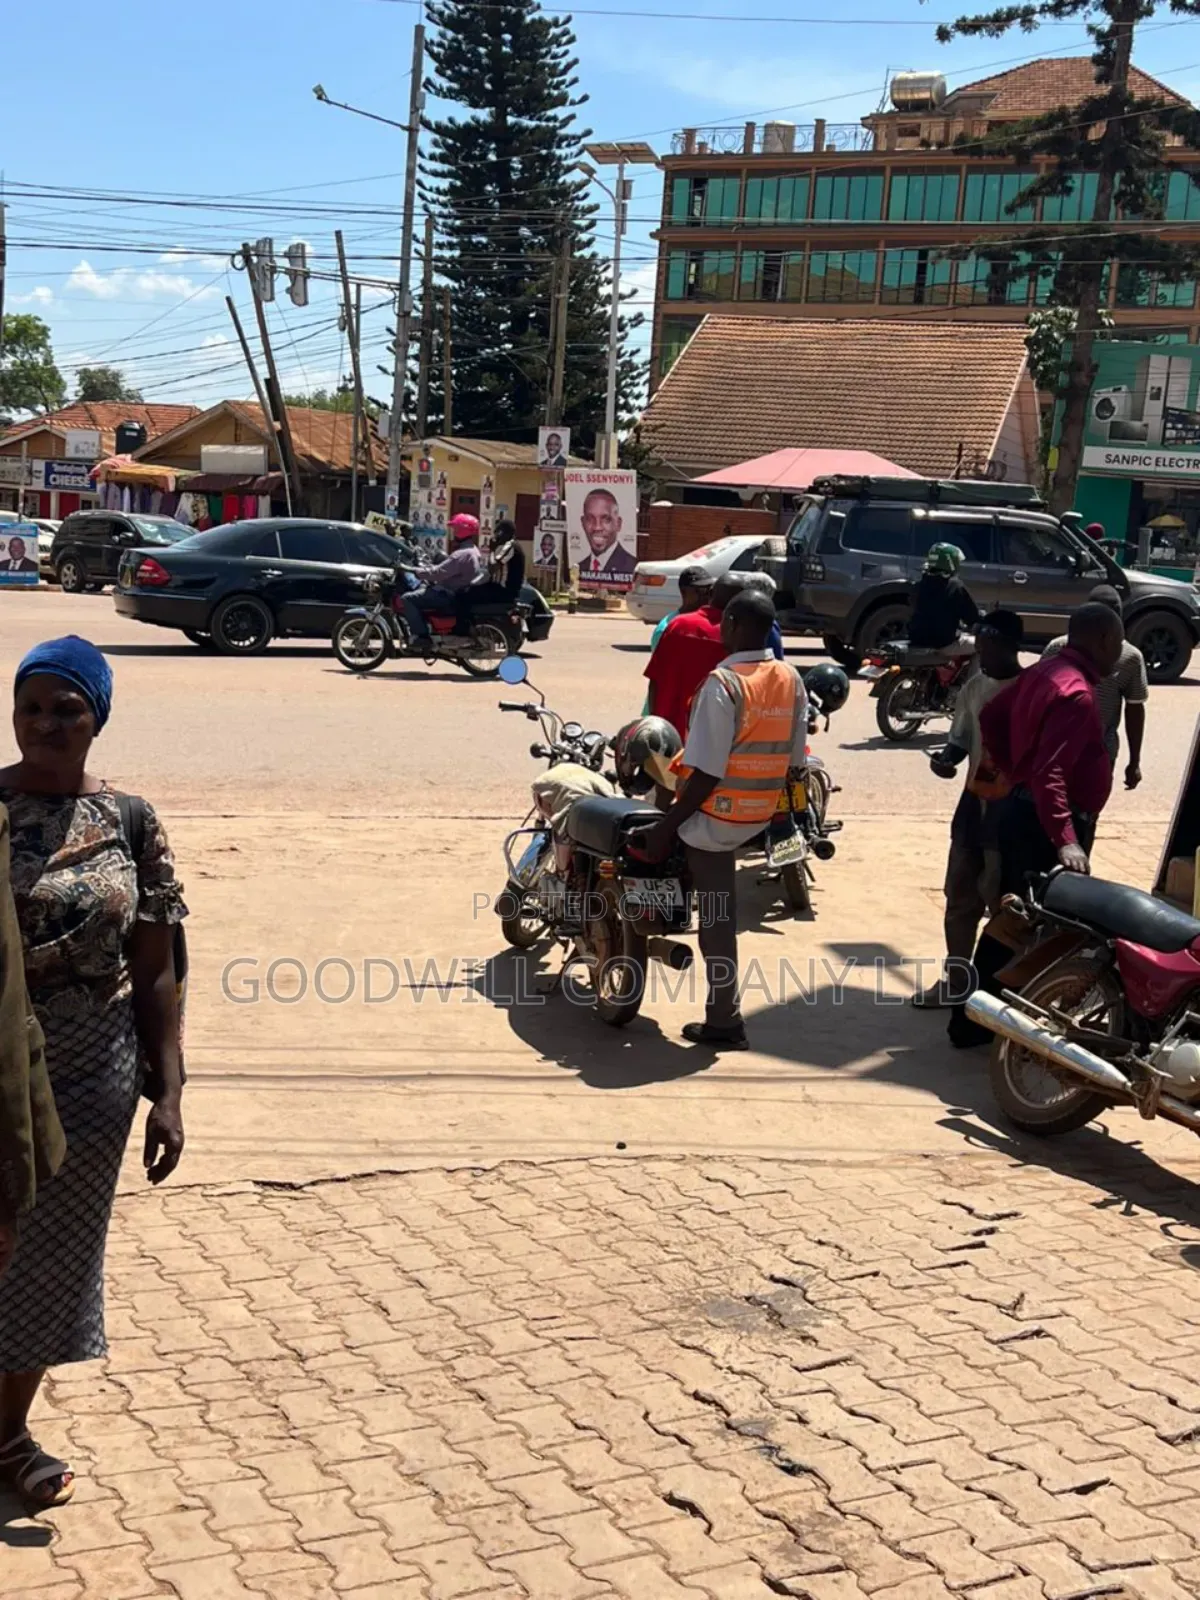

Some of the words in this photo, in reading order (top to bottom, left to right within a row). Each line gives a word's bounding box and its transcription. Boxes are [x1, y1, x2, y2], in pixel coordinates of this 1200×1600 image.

[1104, 453, 1152, 467] SANPIC
[49, 474, 91, 488] CHEESE
[565, 473, 584, 483] JOEL
[586, 473, 634, 484] SSENYONYI
[613, 572, 633, 582] WEST
[643, 879, 676, 892] UFS
